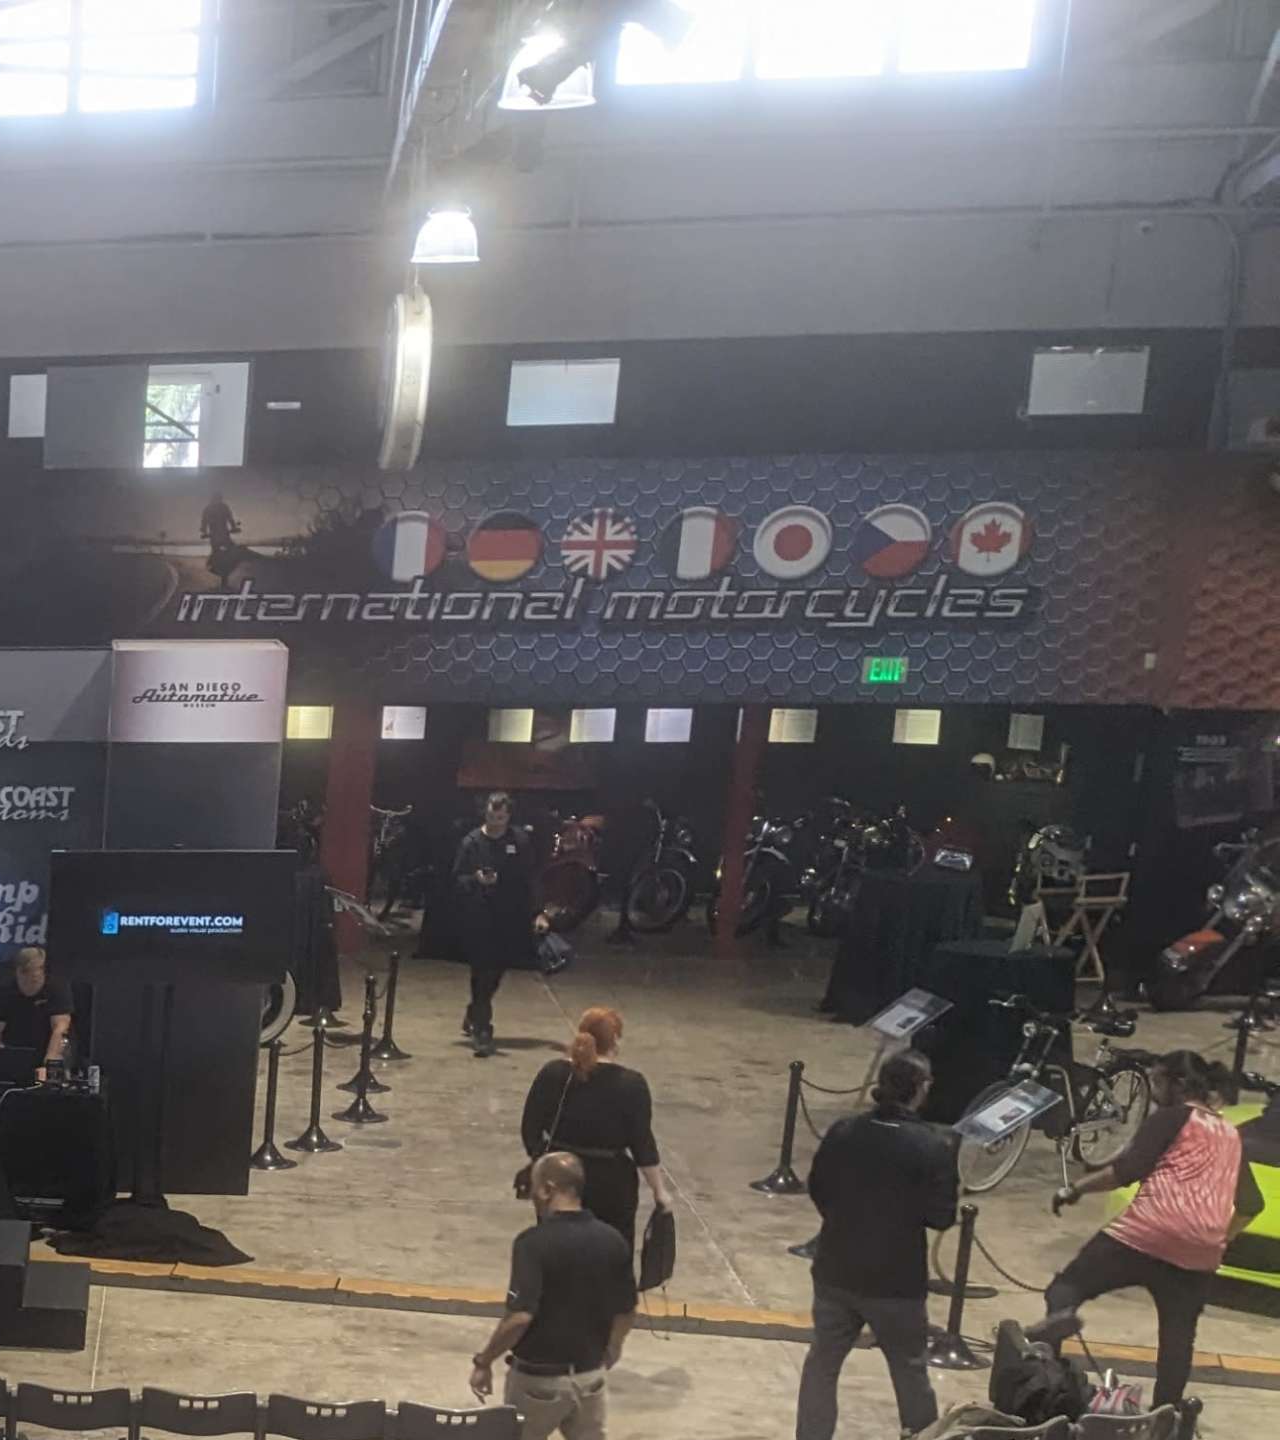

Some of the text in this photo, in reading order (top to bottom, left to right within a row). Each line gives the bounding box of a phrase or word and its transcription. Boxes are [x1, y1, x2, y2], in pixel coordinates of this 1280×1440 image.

[868, 658, 901, 681] EXIT
[160, 682, 242, 692] SAN DIEGO
[132, 688, 264, 704] Automotive
[0, 785, 75, 808] COAST
[120, 916, 243, 926] RENTFOREVENT.COM
